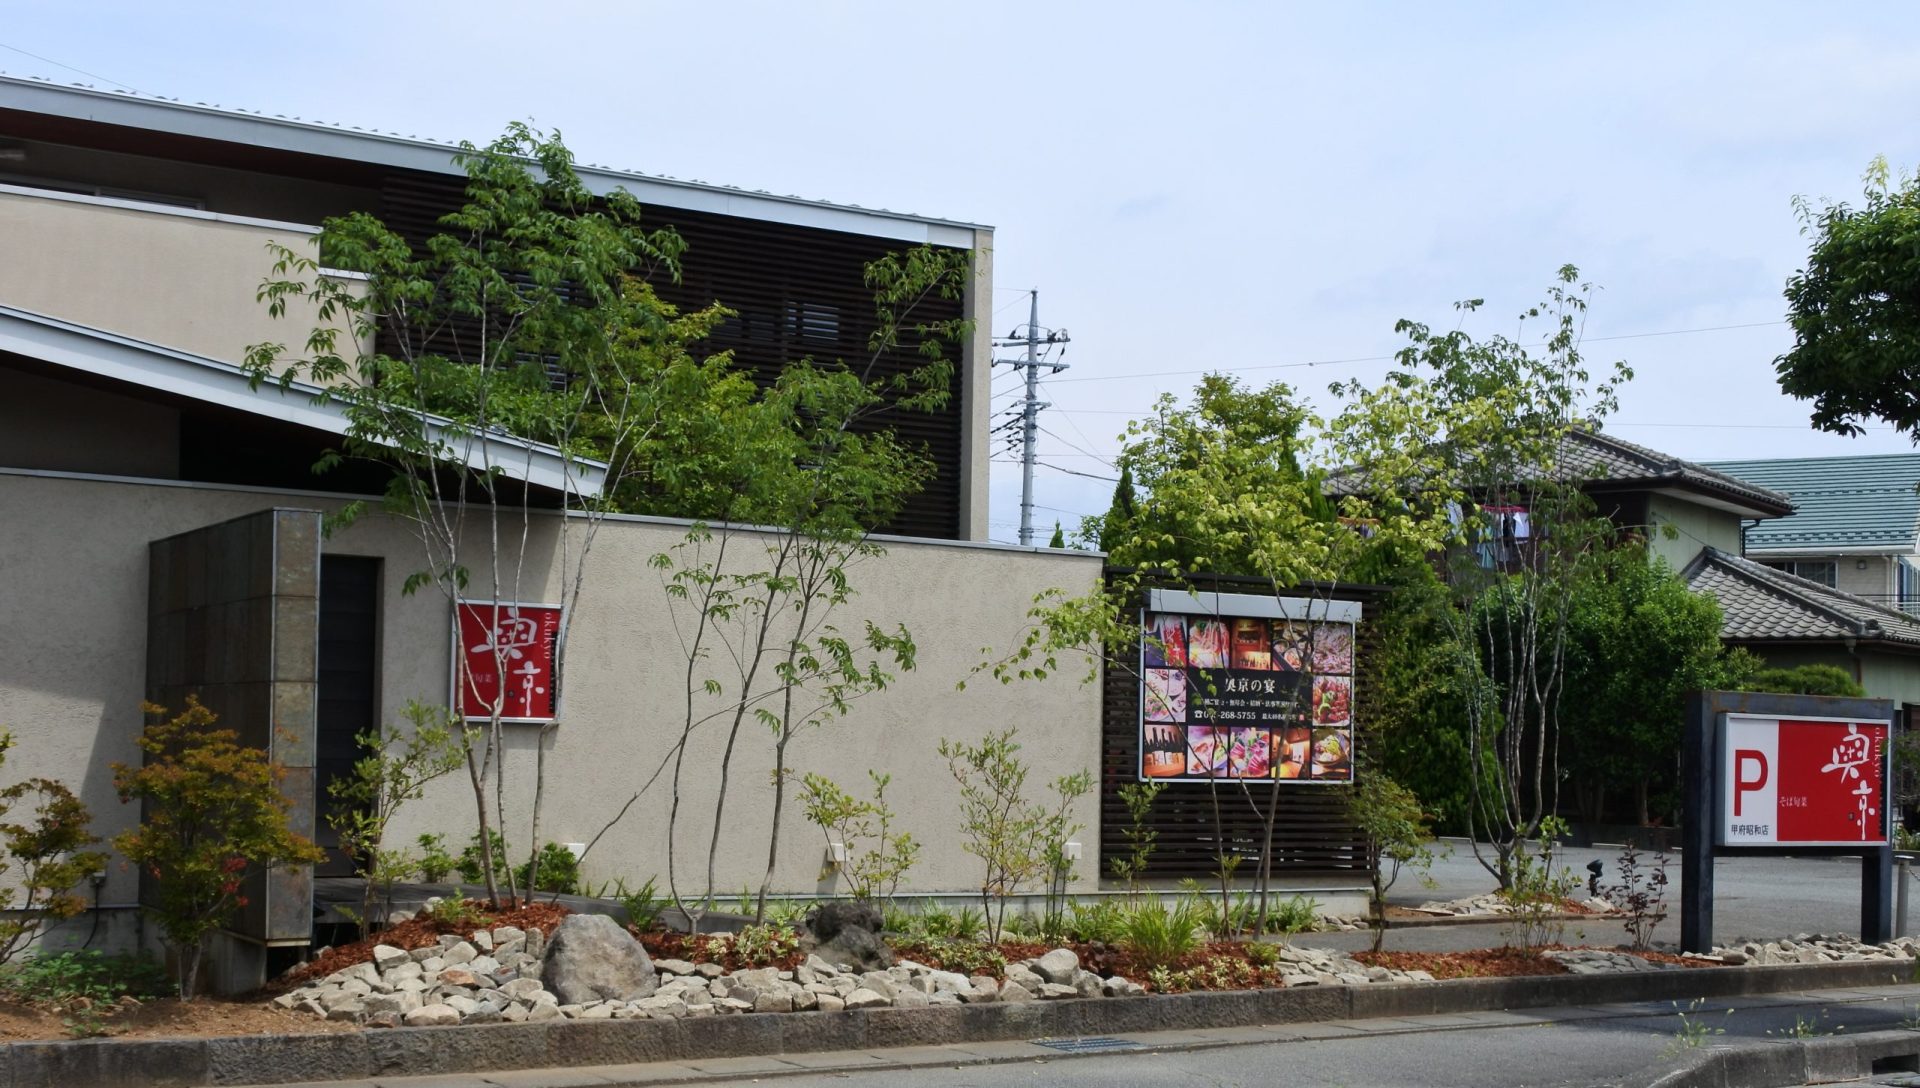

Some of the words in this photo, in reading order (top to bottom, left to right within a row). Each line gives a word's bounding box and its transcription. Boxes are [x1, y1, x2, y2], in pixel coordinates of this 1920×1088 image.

[543, 612, 557, 660] okukyo
[1203, 710, 1256, 720] 0-268-5755
[1872, 726, 1884, 778] okukyo
[1733, 749, 1769, 817] P
[1779, 796, 1808, 807] そば旬菜
[1820, 723, 1876, 841] 奥京
[1731, 824, 1769, 836] 甲府昭和店
